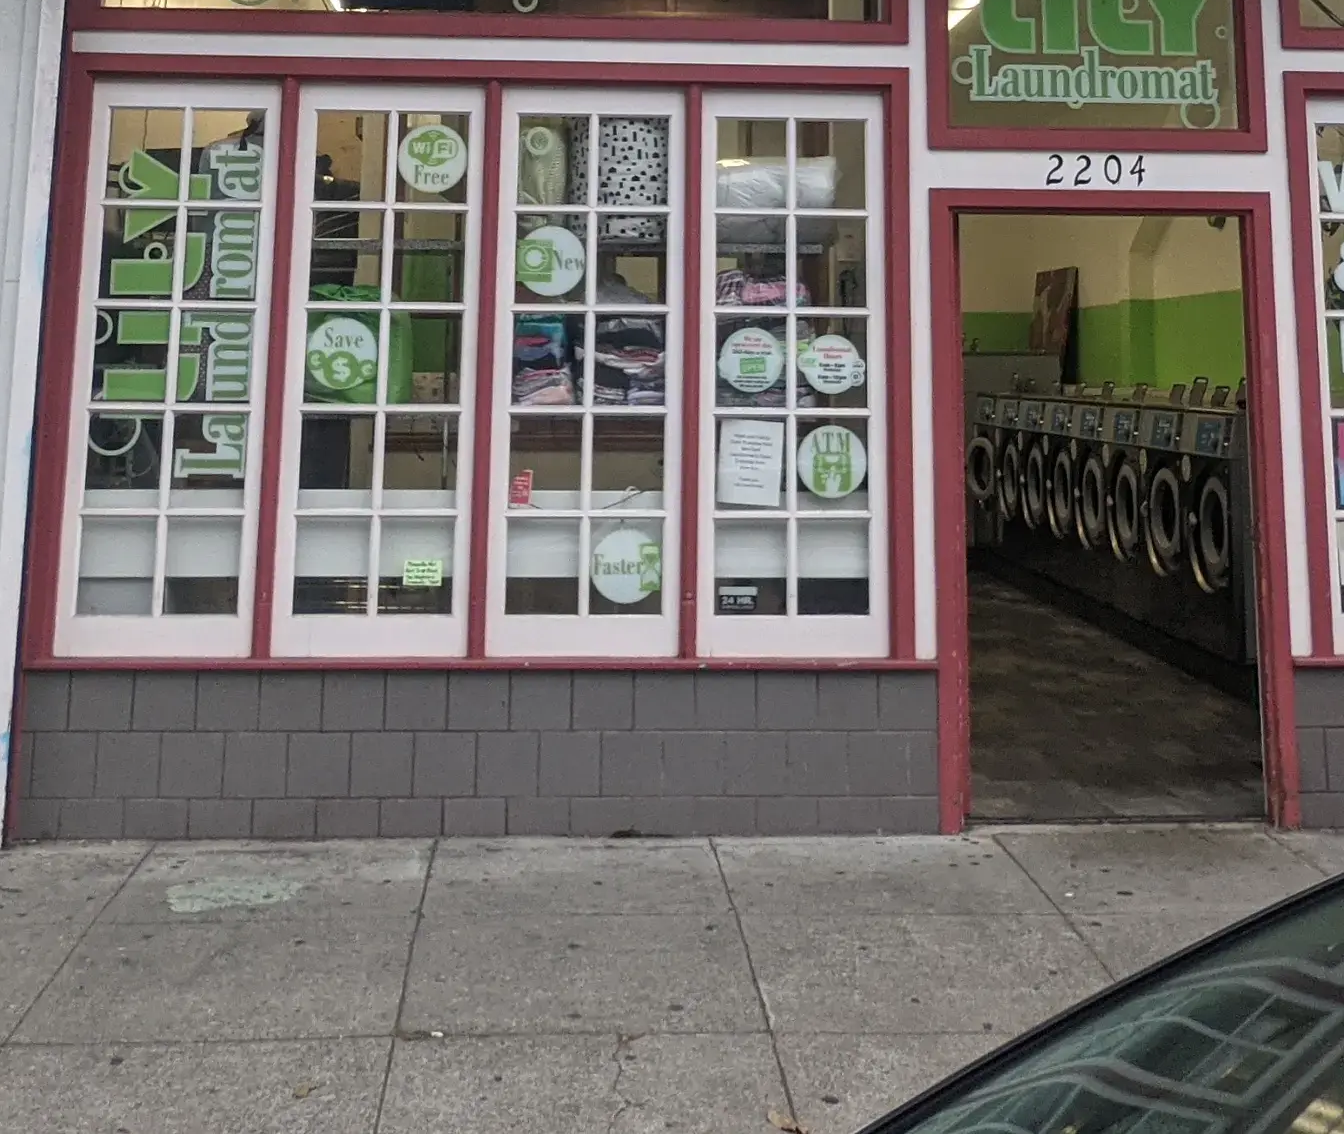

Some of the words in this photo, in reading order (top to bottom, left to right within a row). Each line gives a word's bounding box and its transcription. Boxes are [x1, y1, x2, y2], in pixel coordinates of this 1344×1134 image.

[972, 47, 1216, 101] Laundromat
[414, 164, 451, 186] Free
[1046, 154, 1146, 187] 2204
[552, 249, 585, 272] New
[175, 143, 263, 479] Laundromat
[323, 326, 365, 350] Save
[812, 432, 852, 456] ATM
[593, 553, 645, 577] Faster
